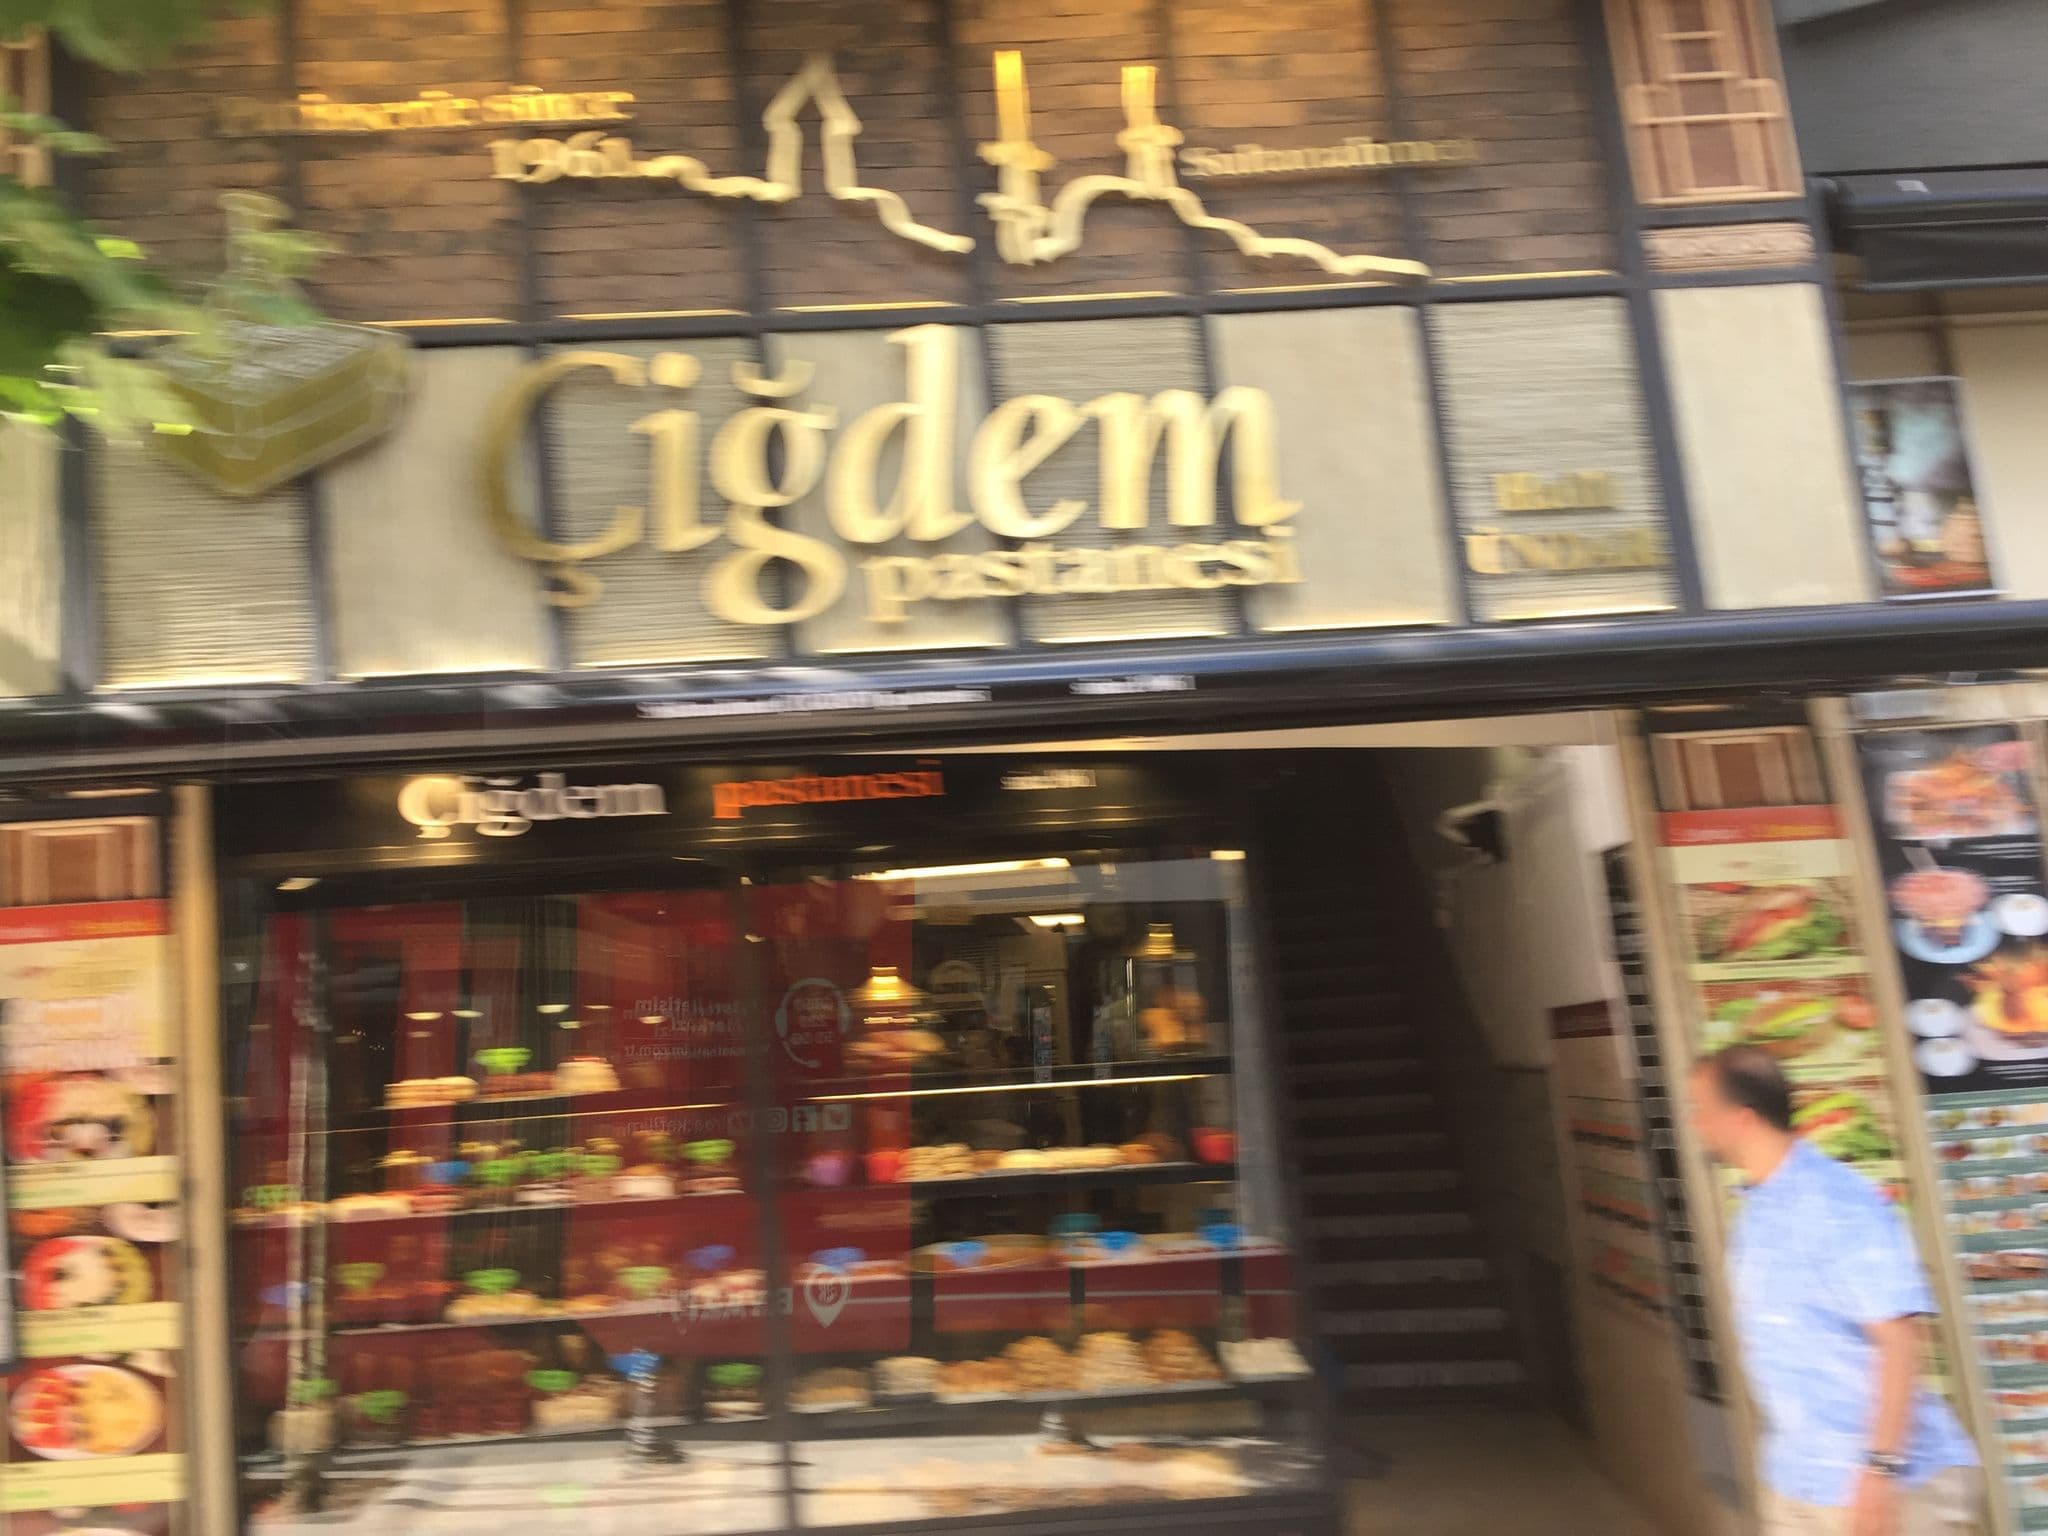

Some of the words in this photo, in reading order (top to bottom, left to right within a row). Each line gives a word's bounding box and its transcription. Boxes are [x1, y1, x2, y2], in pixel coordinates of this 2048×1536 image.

[487, 131, 634, 183] 1961
[482, 325, 1304, 625] Çiğdem
[860, 524, 1304, 624] pastanesi
[397, 771, 670, 840] Çiğdem
[712, 760, 947, 820] pastanesi
